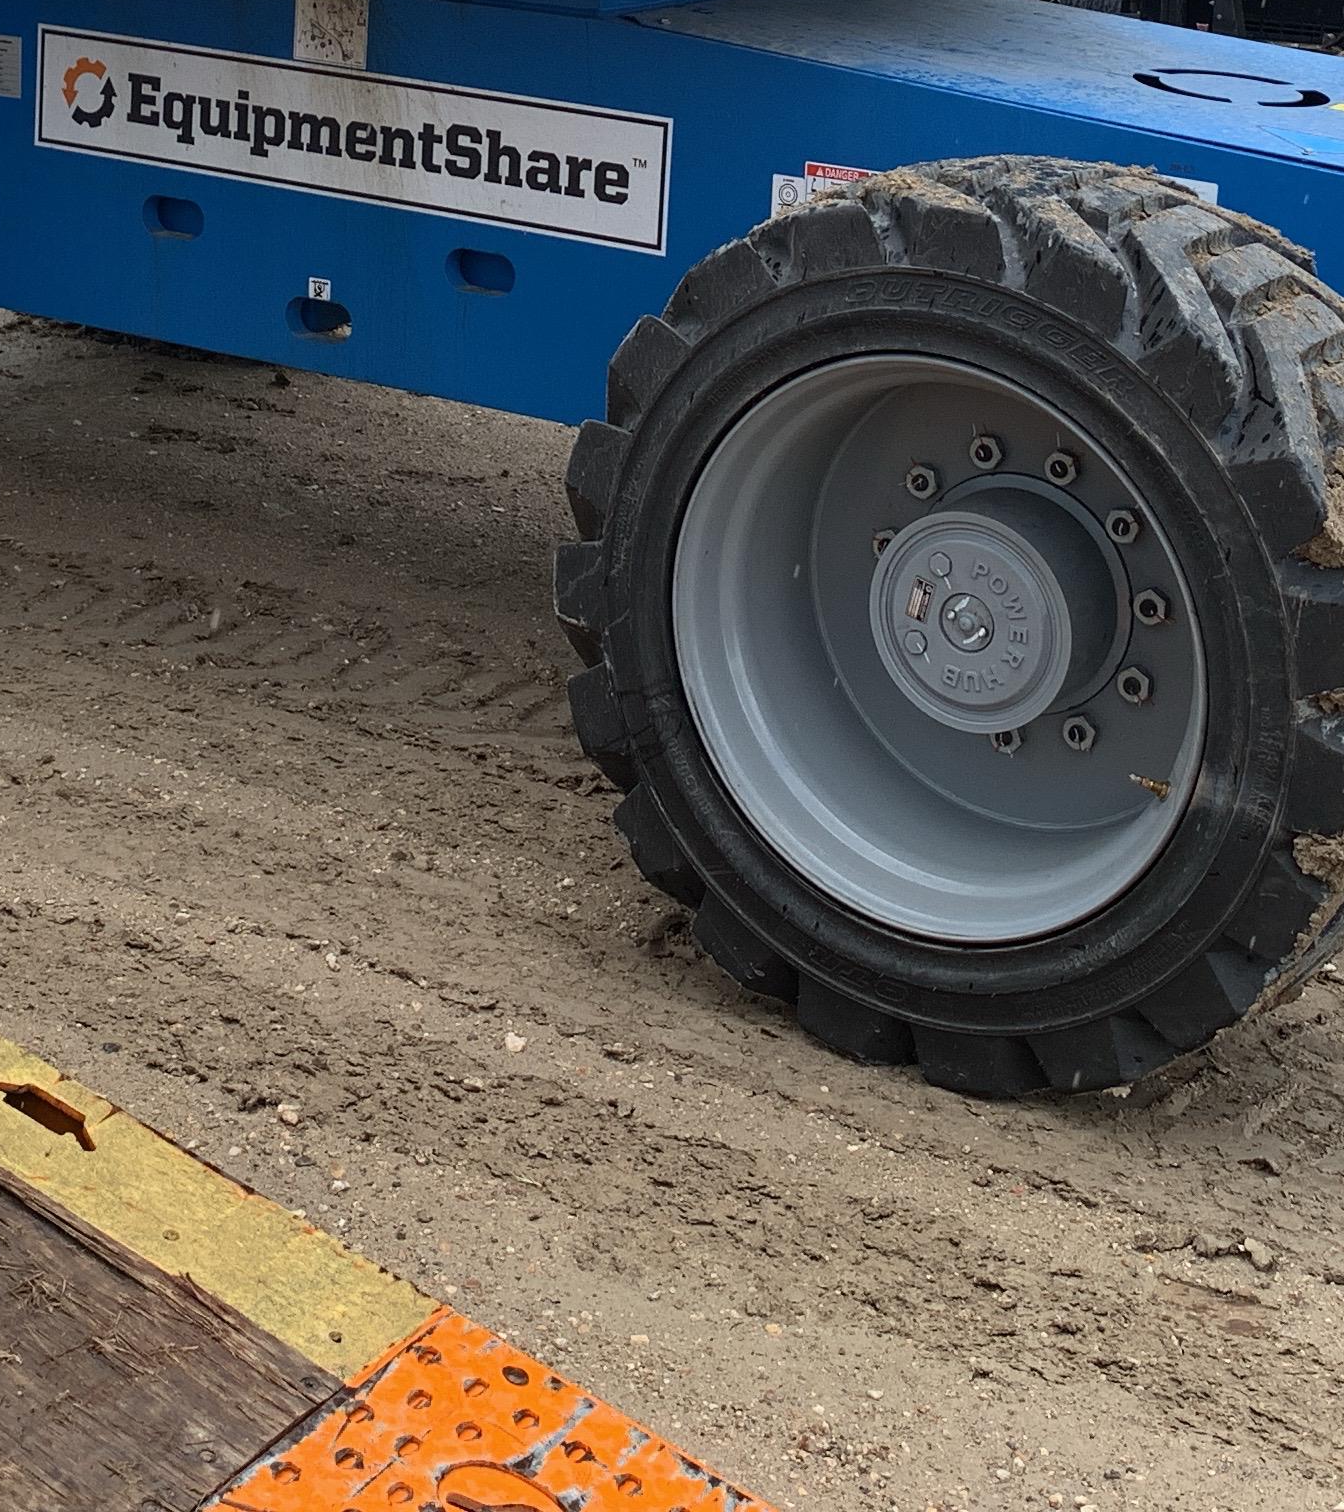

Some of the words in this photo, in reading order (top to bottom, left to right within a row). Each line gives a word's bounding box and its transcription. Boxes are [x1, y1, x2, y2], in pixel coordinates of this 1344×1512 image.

[825, 167, 859, 182] DANGER
[846, 277, 1137, 396] OUTRIGGER
[971, 558, 1028, 669] POWER
[942, 663, 1006, 693] HUB
